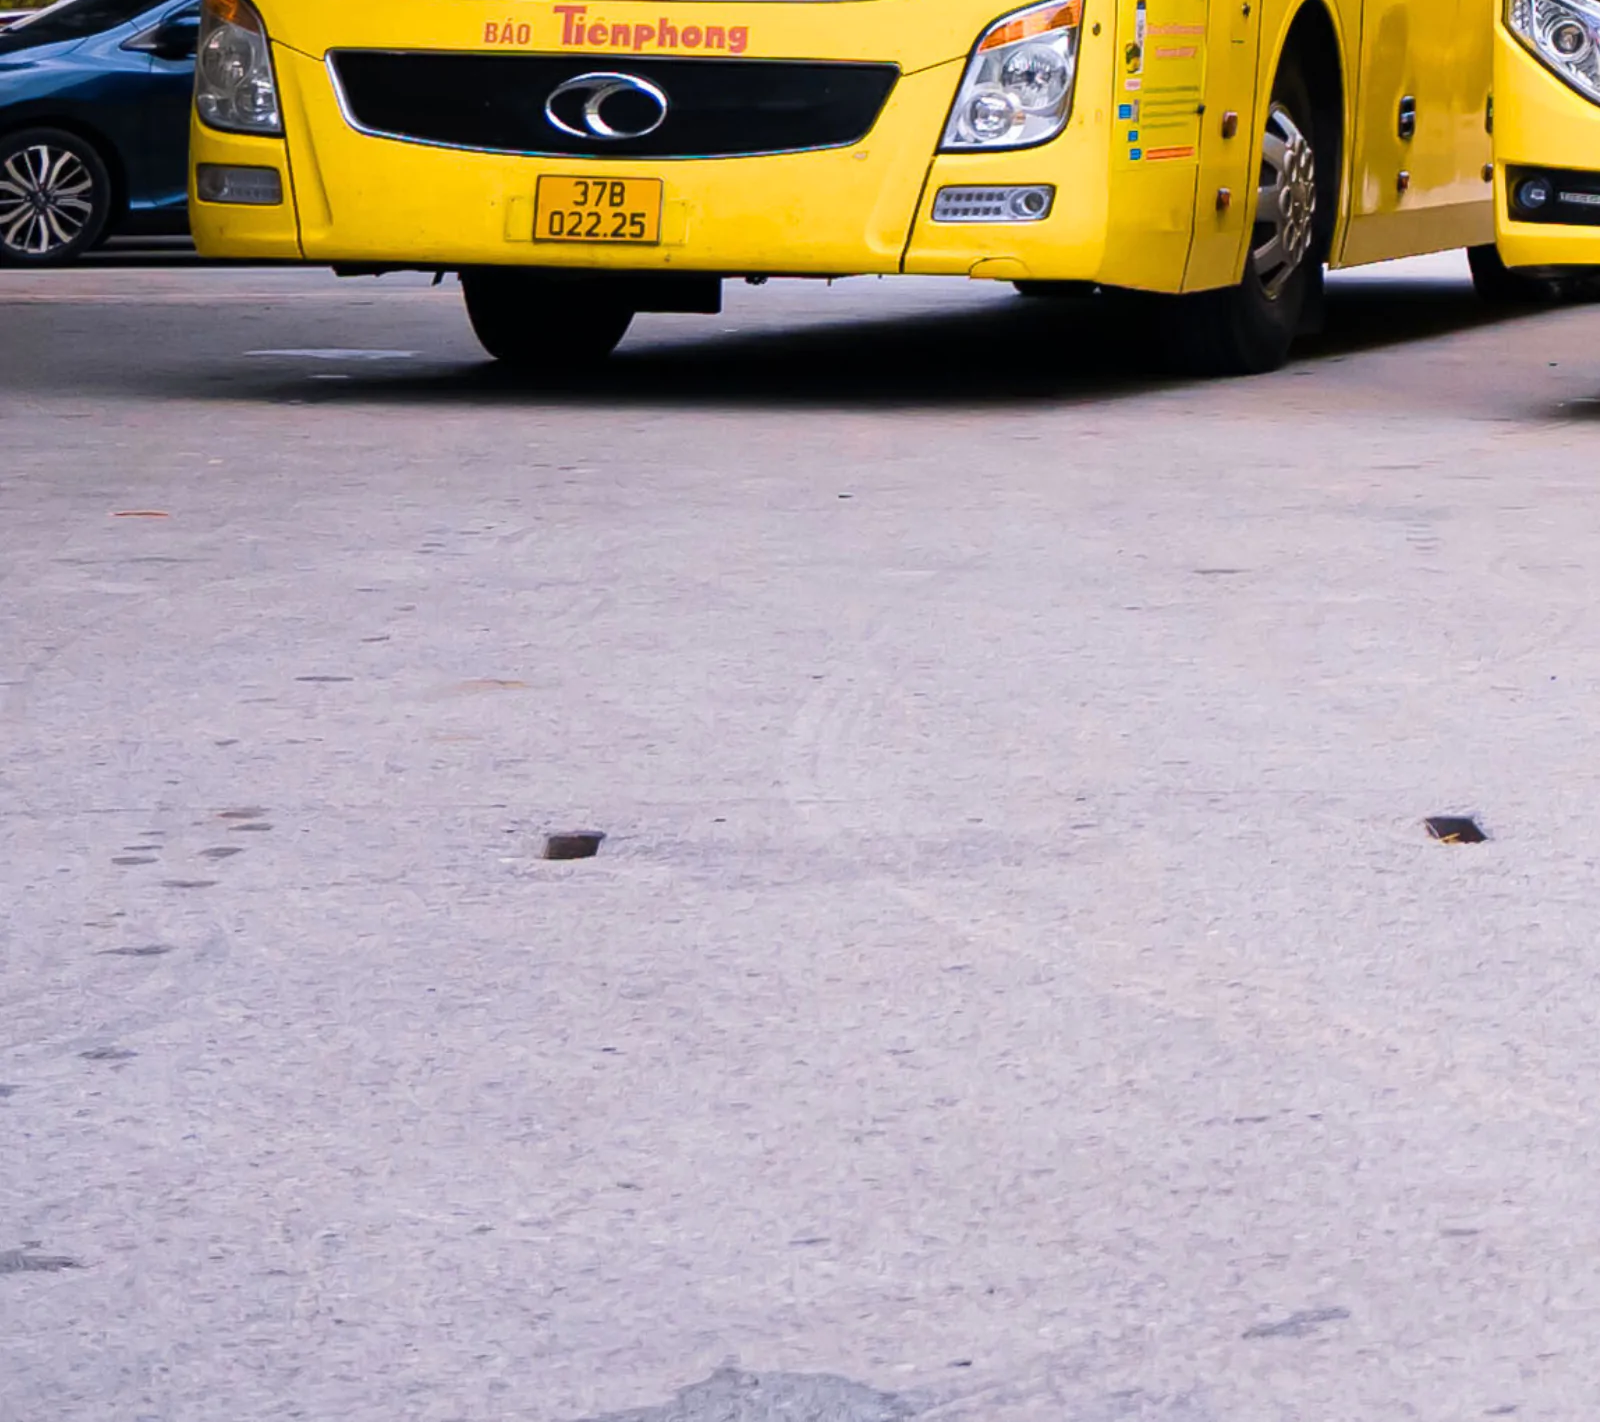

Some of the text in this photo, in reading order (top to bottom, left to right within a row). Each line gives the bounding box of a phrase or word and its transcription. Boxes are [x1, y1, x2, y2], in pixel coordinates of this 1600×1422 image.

[483, 18, 532, 45] BÁO
[573, 181, 625, 207] 37B
[549, 210, 646, 238] 022.25
